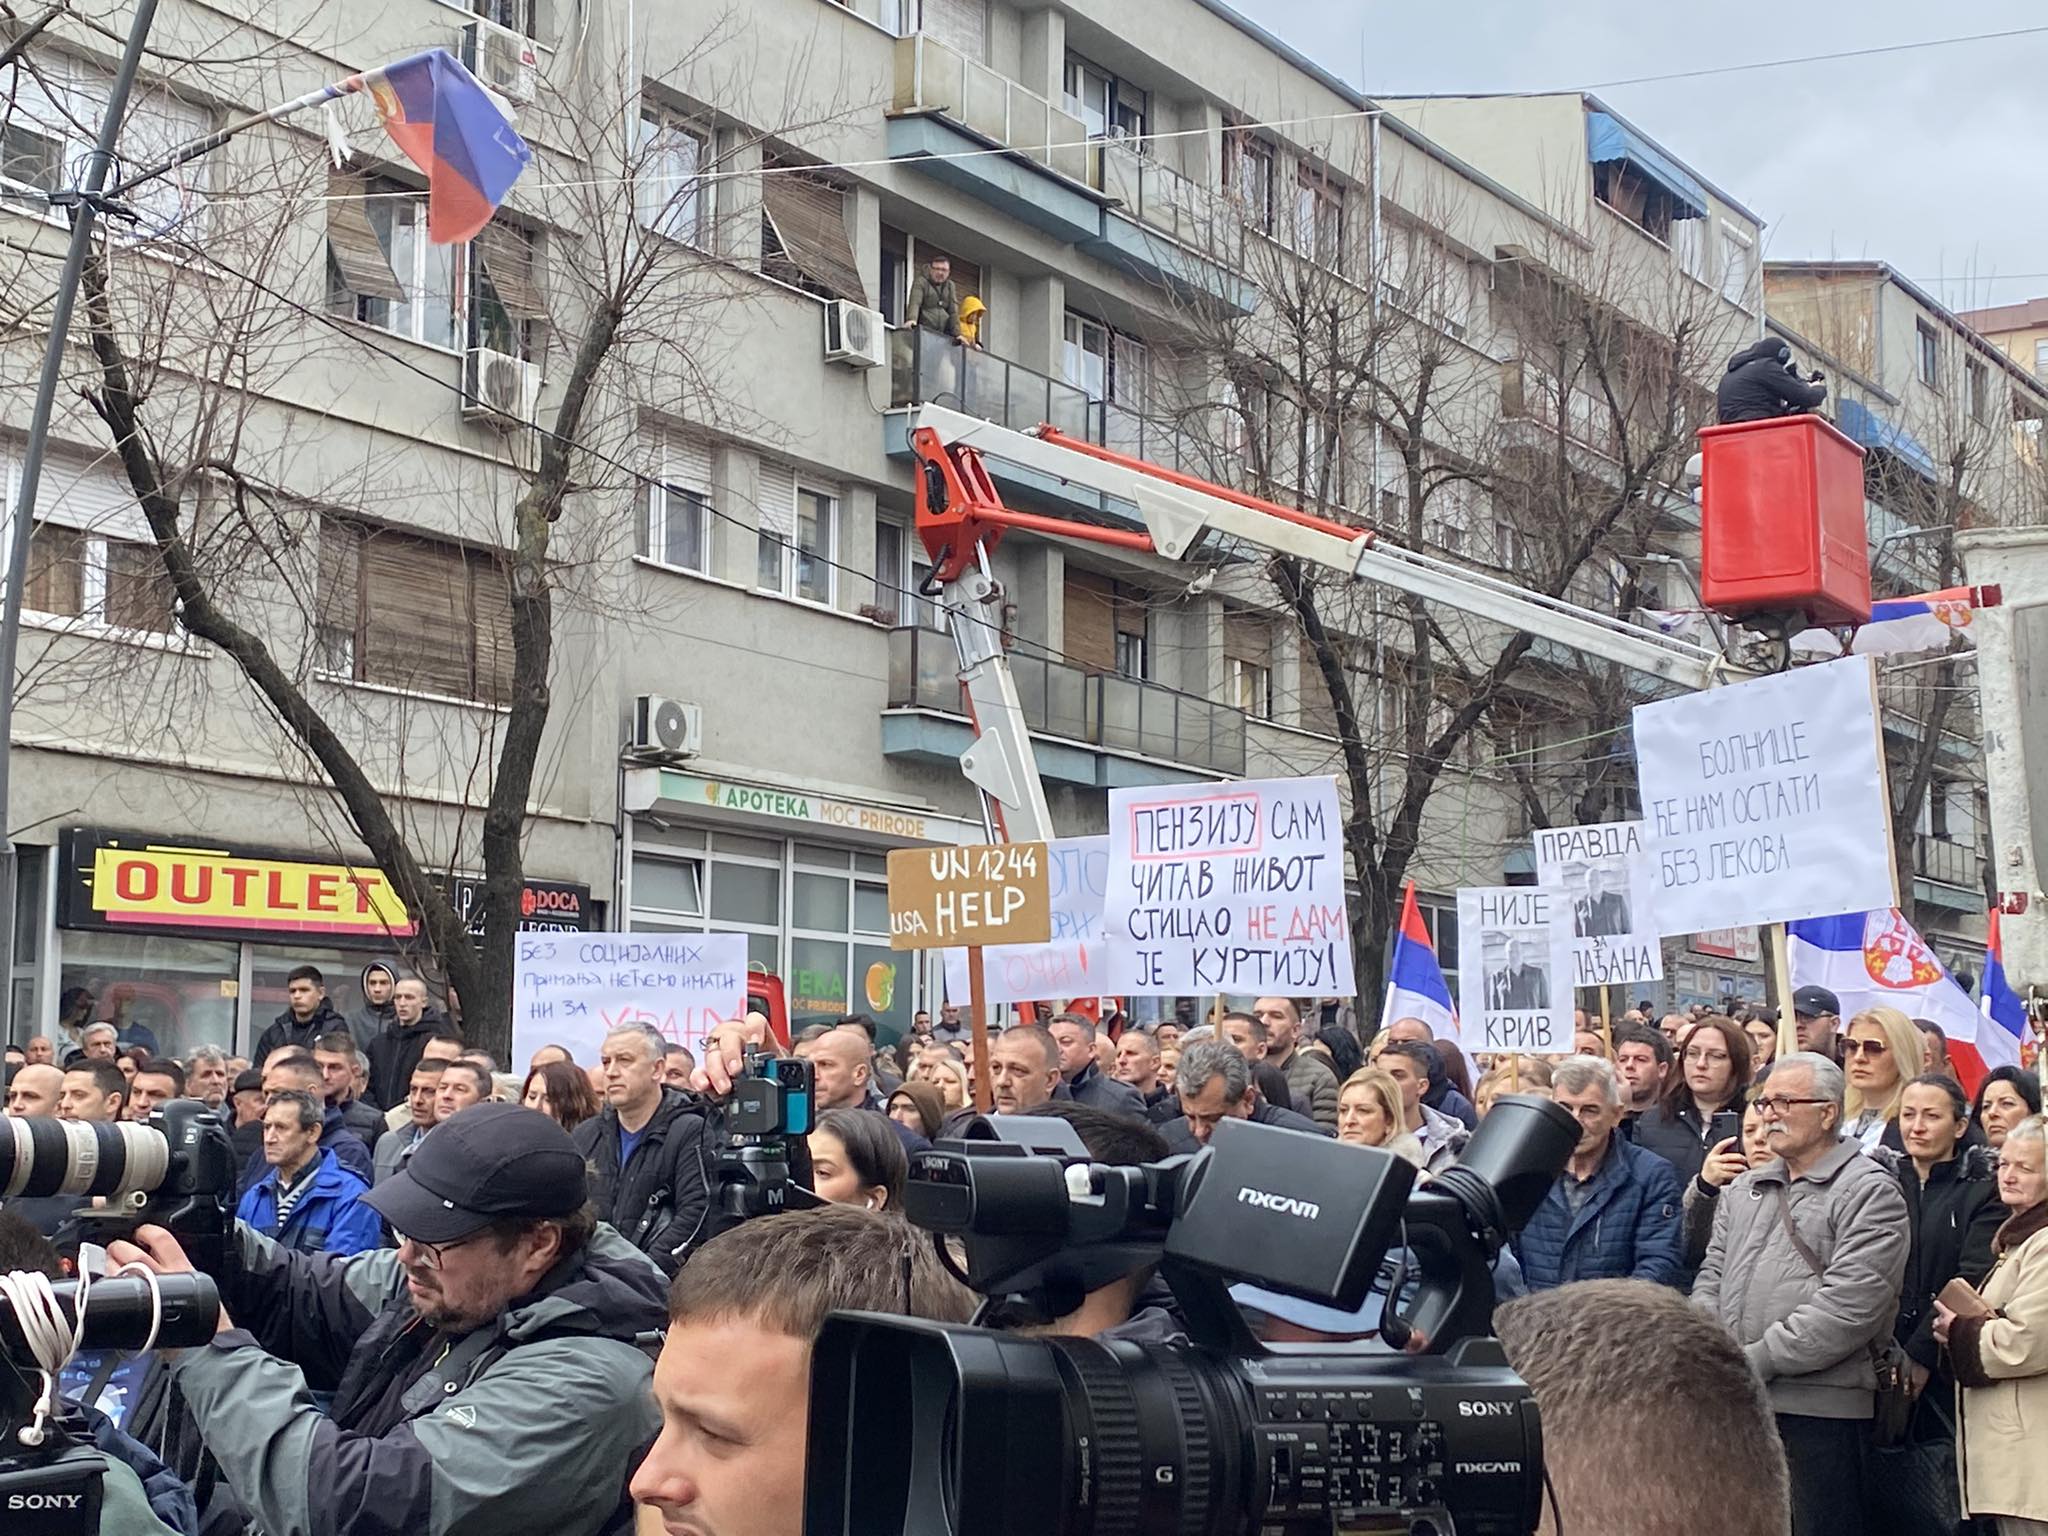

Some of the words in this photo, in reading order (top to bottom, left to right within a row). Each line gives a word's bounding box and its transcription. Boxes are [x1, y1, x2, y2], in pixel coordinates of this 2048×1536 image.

[1699, 721, 1810, 779] БОЛНИЦЕ
[726, 787, 809, 818] APOTEKA
[820, 803, 855, 825] MOC
[859, 810, 925, 837] PRIRODE
[1686, 791, 1726, 834] НАМ
[1732, 773, 1822, 824] ОСТАТИ
[1134, 801, 1258, 854] ПЕНЗИЈУ
[1271, 800, 1326, 841] САМ
[1541, 826, 1641, 863] ПРАВДА
[930, 849, 970, 881] UN
[978, 847, 1037, 881] 1244
[1131, 860, 1213, 905] ЧИТАВ
[1233, 854, 1325, 895] ЖИВОТ
[1661, 848, 1700, 888] БЕЗ
[1707, 833, 1790, 880] ЛЕКОВА
[115, 860, 381, 913] OUTLET
[537, 890, 580, 911] DOCA
[890, 910, 928, 936] USA
[936, 886, 1026, 936] HELP
[1128, 907, 1231, 942] СТИЦАО
[1248, 905, 1278, 941] НЕ
[1283, 904, 1344, 945] ДАМ
[1480, 894, 1550, 926] НИЈЕ
[1136, 951, 1164, 986] ЈЕ
[1193, 943, 1338, 990] КУРТИЈУ!
[1485, 1015, 1552, 1047] КРИВ
[1458, 1401, 1514, 1416] SONY
[1156, 1465, 1174, 1483] G
[8, 1494, 82, 1509] SONY
